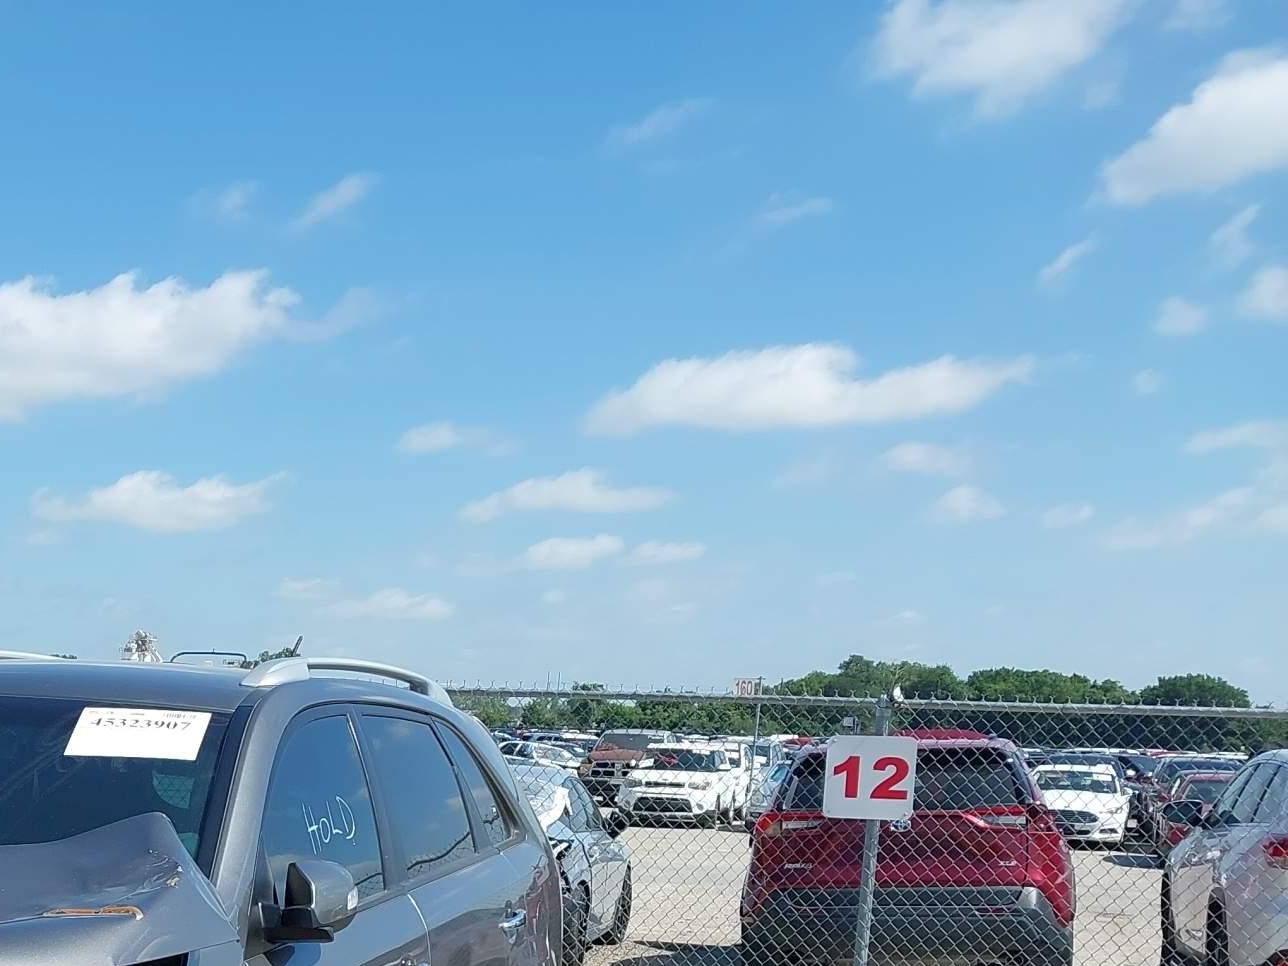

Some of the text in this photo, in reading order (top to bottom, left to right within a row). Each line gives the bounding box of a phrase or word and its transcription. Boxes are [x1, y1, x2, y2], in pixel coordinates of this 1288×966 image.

[735, 679, 753, 696] 160
[90, 717, 192, 731] 45323907
[833, 755, 910, 800] 12
[301, 795, 355, 856] HOLD
